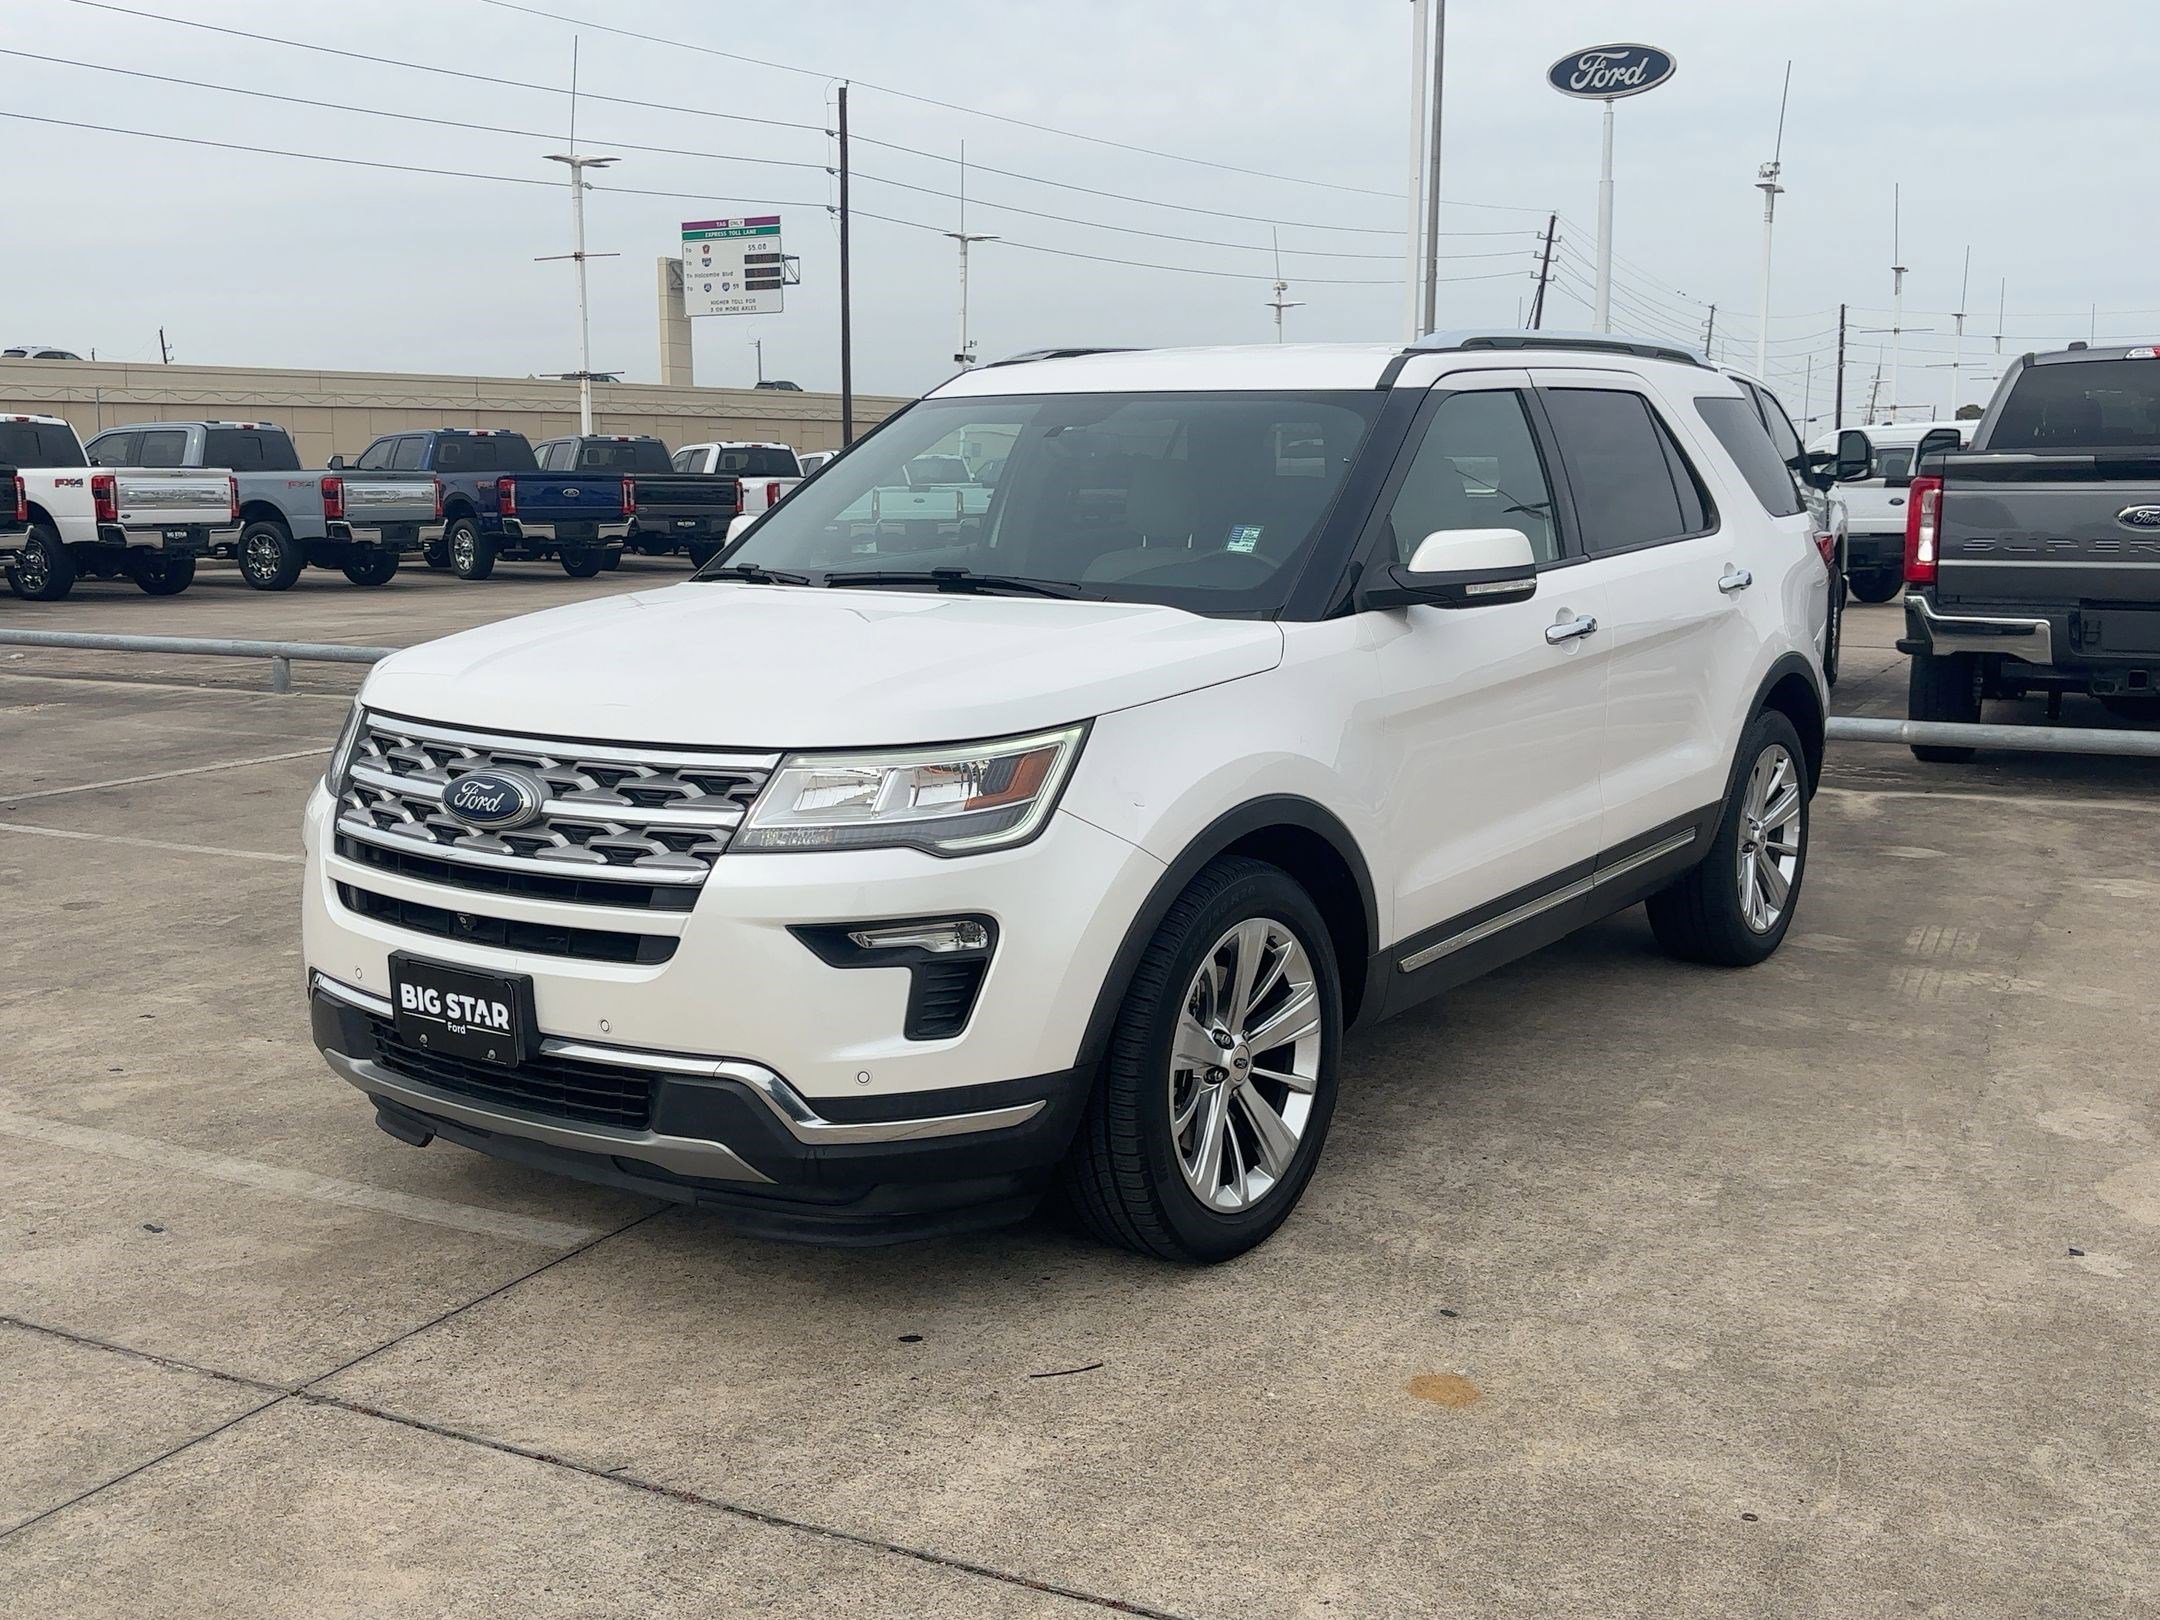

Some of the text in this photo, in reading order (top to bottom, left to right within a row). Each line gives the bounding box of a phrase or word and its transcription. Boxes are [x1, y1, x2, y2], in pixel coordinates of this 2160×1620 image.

[1570, 51, 1649, 90] Ford
[705, 229, 727, 238] EXPRESS
[55, 478, 83, 488] FX4
[2133, 510, 2160, 524] For
[454, 781, 505, 812] Ford
[400, 982, 510, 1030] BIG STAR
[447, 1021, 467, 1035] Ford
